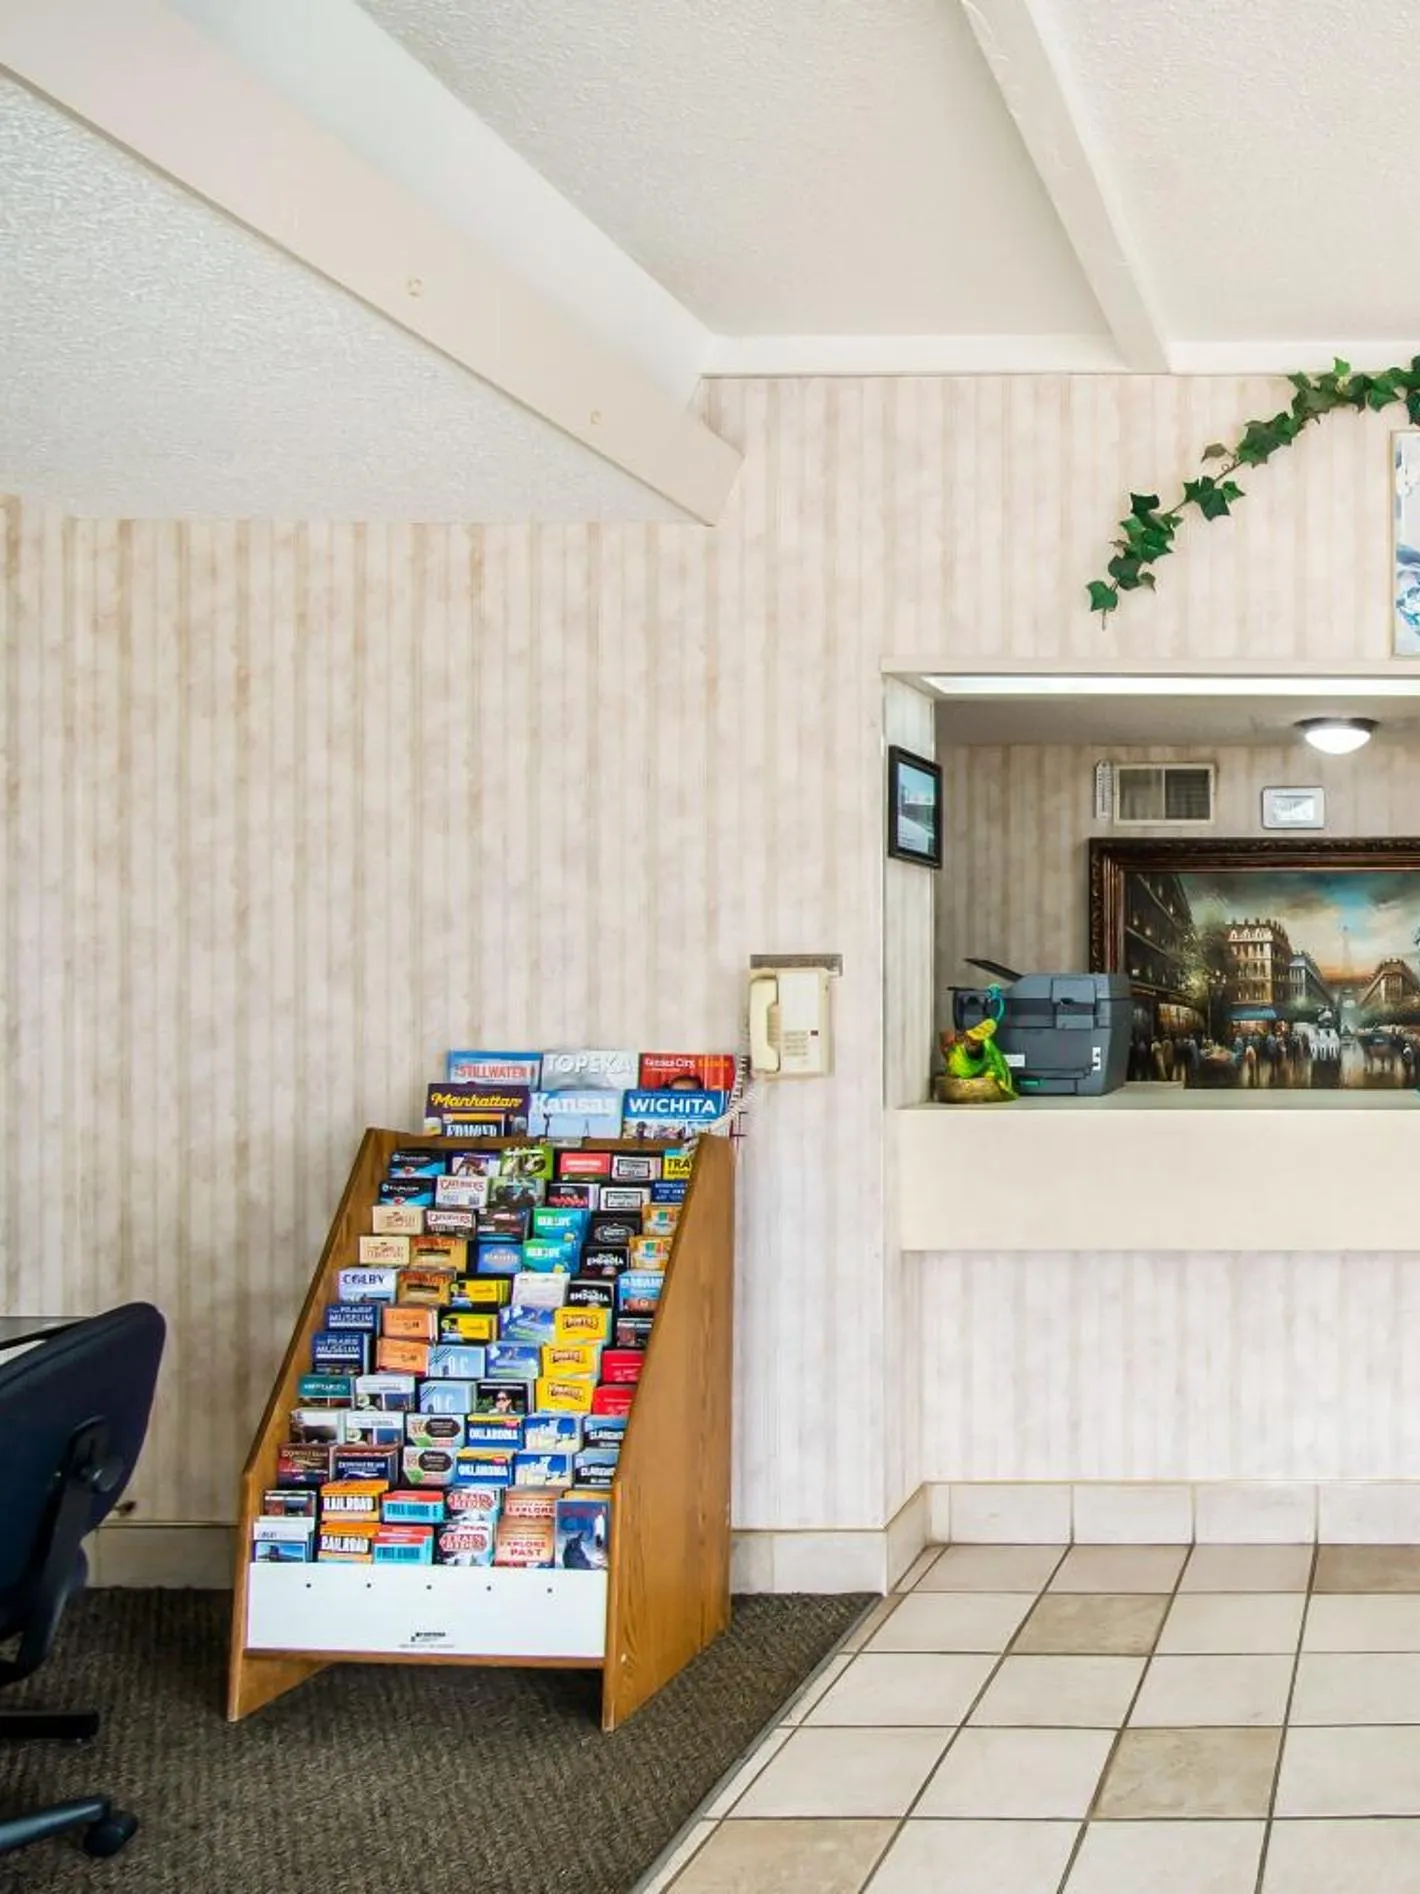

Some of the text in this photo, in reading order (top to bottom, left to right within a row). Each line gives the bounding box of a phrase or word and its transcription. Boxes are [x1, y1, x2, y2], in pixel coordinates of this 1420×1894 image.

[546, 1053, 633, 1073] TOPEKA
[431, 1092, 523, 1108] Manhattan
[531, 1091, 614, 1114] Kansas
[629, 1099, 716, 1114] WICHITA
[343, 1273, 385, 1285] COLBY
